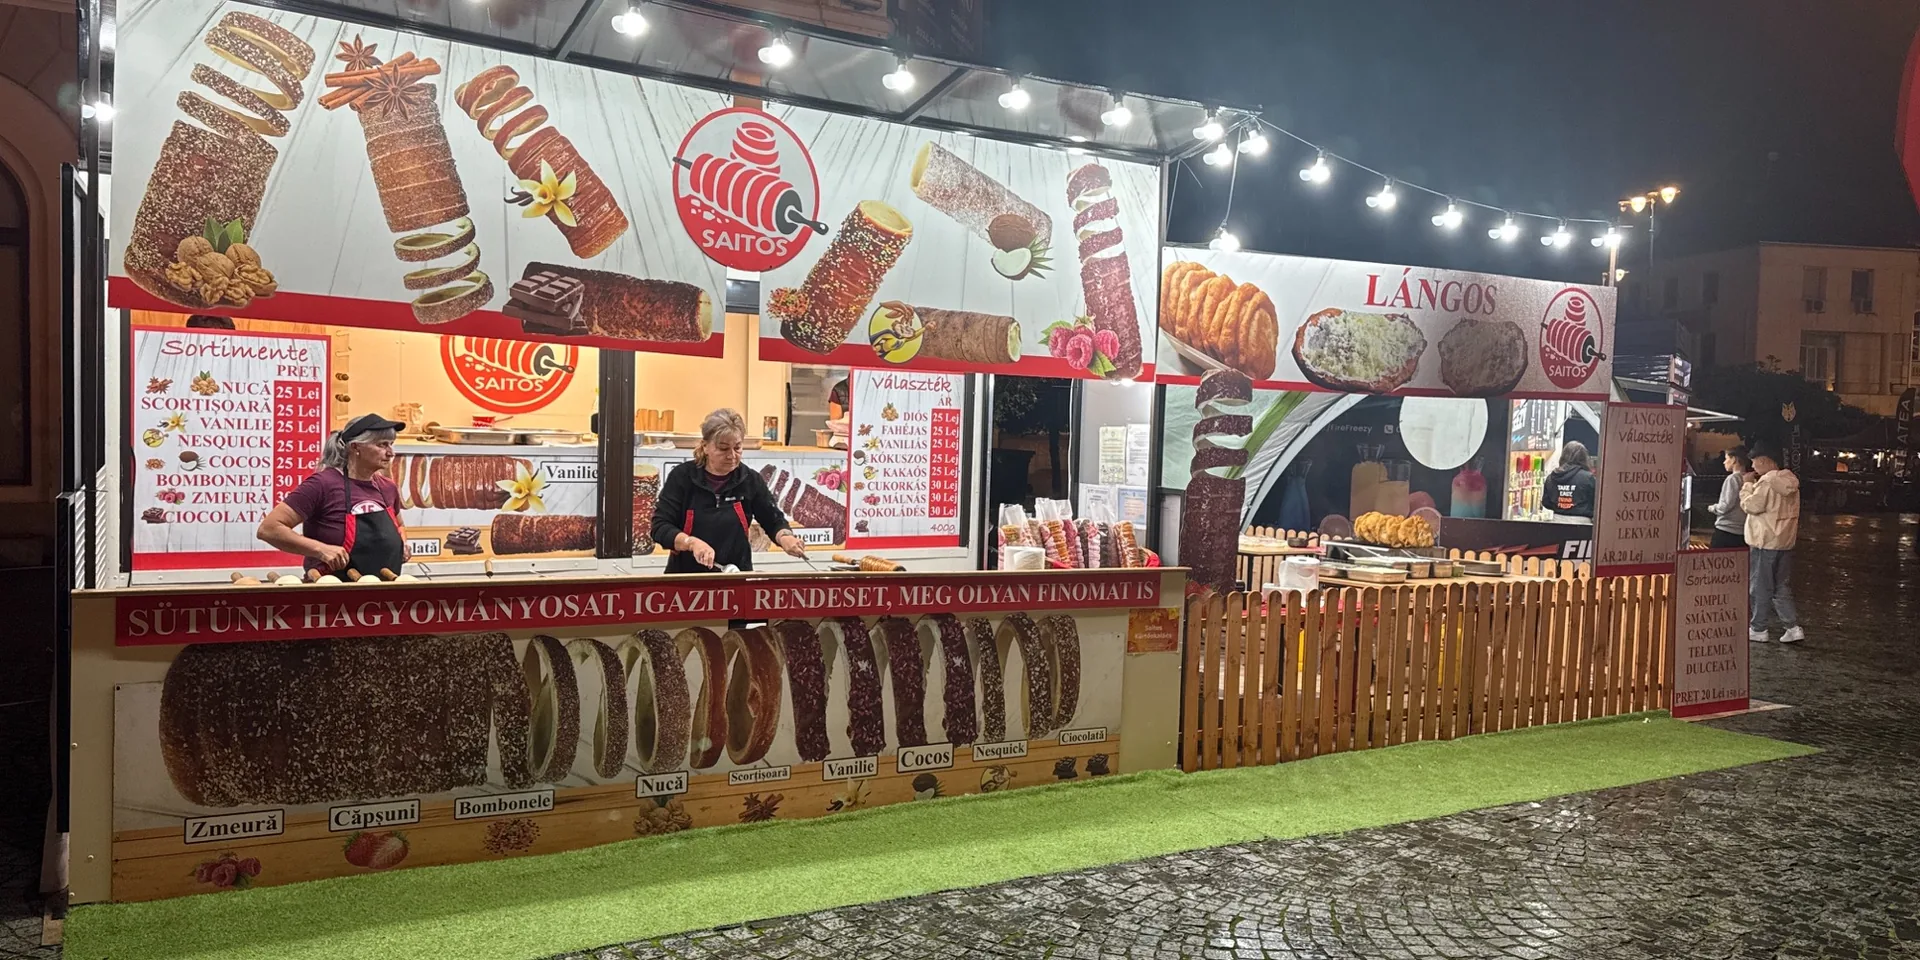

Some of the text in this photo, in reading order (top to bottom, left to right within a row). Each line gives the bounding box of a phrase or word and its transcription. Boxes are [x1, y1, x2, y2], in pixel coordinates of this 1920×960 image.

[702, 229, 788, 257] SAITOS
[1364, 268, 1497, 315] LÁNGOS
[161, 338, 308, 362] Sortimente
[1548, 364, 1588, 378] SAITOS
[222, 380, 320, 400] NUCĂ 25 Lei
[474, 376, 544, 392] SAITOS
[872, 374, 952, 392] Választék
[938, 394, 952, 406] ÁR
[141, 397, 320, 418] SCORȚIȘOARĂ 25 Lei
[904, 410, 928, 422] DIÓS
[932, 413, 943, 422] 25
[200, 418, 320, 434] VANILIE 25 Lei
[882, 424, 927, 435] FAHÉJAS
[932, 427, 943, 435] 25
[1619, 428, 1674, 444] Választék
[178, 435, 320, 453] NESQUICK 25 Lei
[879, 438, 927, 449] VANILIÁS
[932, 439, 942, 448] 25
[208, 455, 320, 469] COCOS 25 Lei
[870, 451, 927, 463] KÓKUSZOS
[932, 454, 942, 463] 25
[1631, 452, 1656, 464] SIMA
[546, 465, 598, 479] Vanilie
[883, 465, 927, 477] KAKAÓS
[932, 467, 942, 476] 25
[156, 474, 272, 487] BOMBONELE
[276, 474, 293, 487] 30
[868, 480, 926, 491] CUKORKÁS
[931, 481, 941, 489] 30
[192, 488, 269, 504] ZMEURĂ
[882, 492, 926, 504] MÁLNÁS
[930, 493, 941, 502] 30
[1623, 491, 1660, 502] SAJTOS
[854, 504, 926, 518] CSOKOLÁDÉS
[930, 507, 940, 516] 30
[1616, 506, 1664, 522] SÓS TÚRÓ
[931, 524, 955, 534] 400g
[1618, 525, 1660, 539] LEKVÁR
[1618, 551, 1627, 561] 20
[1686, 572, 1740, 586] Sortimente
[1694, 594, 1729, 606] SIMPLU
[128, 581, 1154, 638] SÜTÜNK HAGYOMÁNYOSAT, IGAZIT, RENDESET, MEG OLYAN FINOMAT IS
[1688, 644, 1734, 658] TELEMEA
[1701, 690, 1710, 700] 20
[1712, 688, 1724, 699] Lei
[1061, 730, 1105, 744] Ciocolată
[976, 742, 1025, 759] Nesquick
[901, 748, 950, 768] Cocos
[827, 759, 875, 777] Vanilie
[731, 767, 788, 784] Scorțișoară
[641, 776, 684, 796] Nucă
[459, 795, 551, 817] Bombonele
[334, 804, 416, 831] Căpșuni
[190, 814, 278, 839] Zmeură
